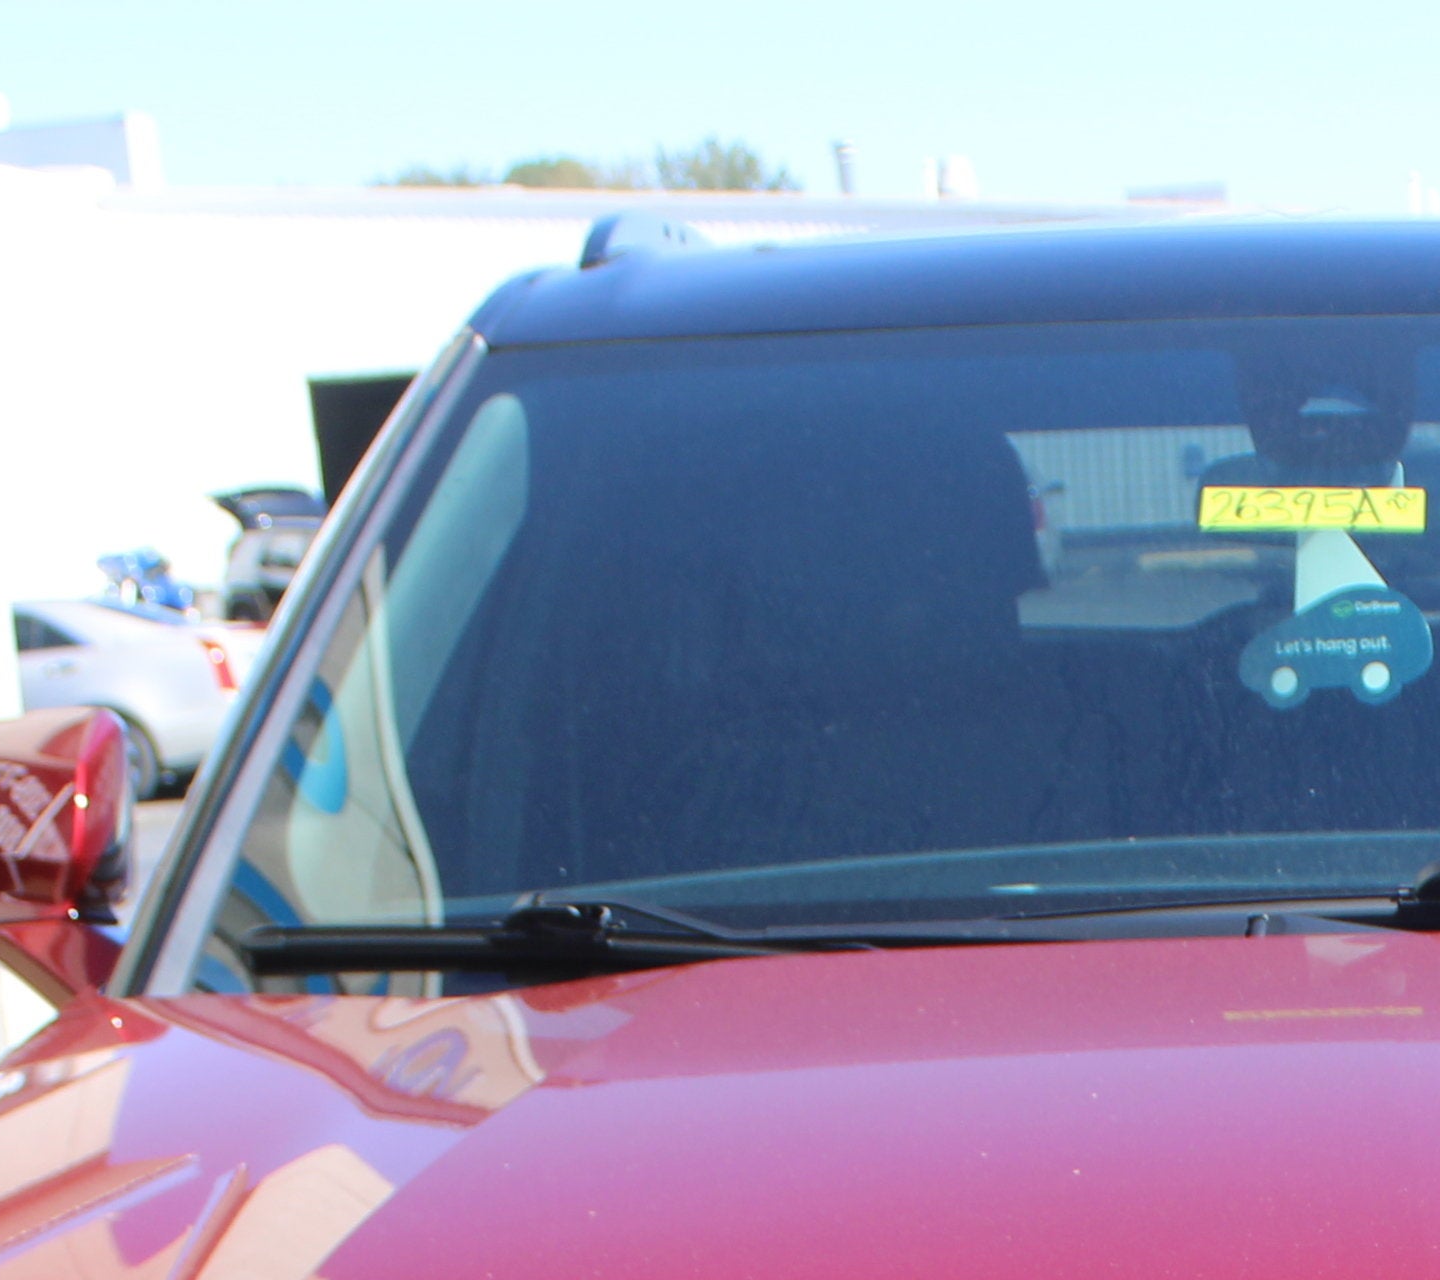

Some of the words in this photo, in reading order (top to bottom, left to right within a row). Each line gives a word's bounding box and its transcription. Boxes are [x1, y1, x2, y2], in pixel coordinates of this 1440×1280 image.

[1211, 488, 1380, 524] 26395A
[1275, 639, 1312, 655] Let's
[1315, 637, 1357, 658] hang
